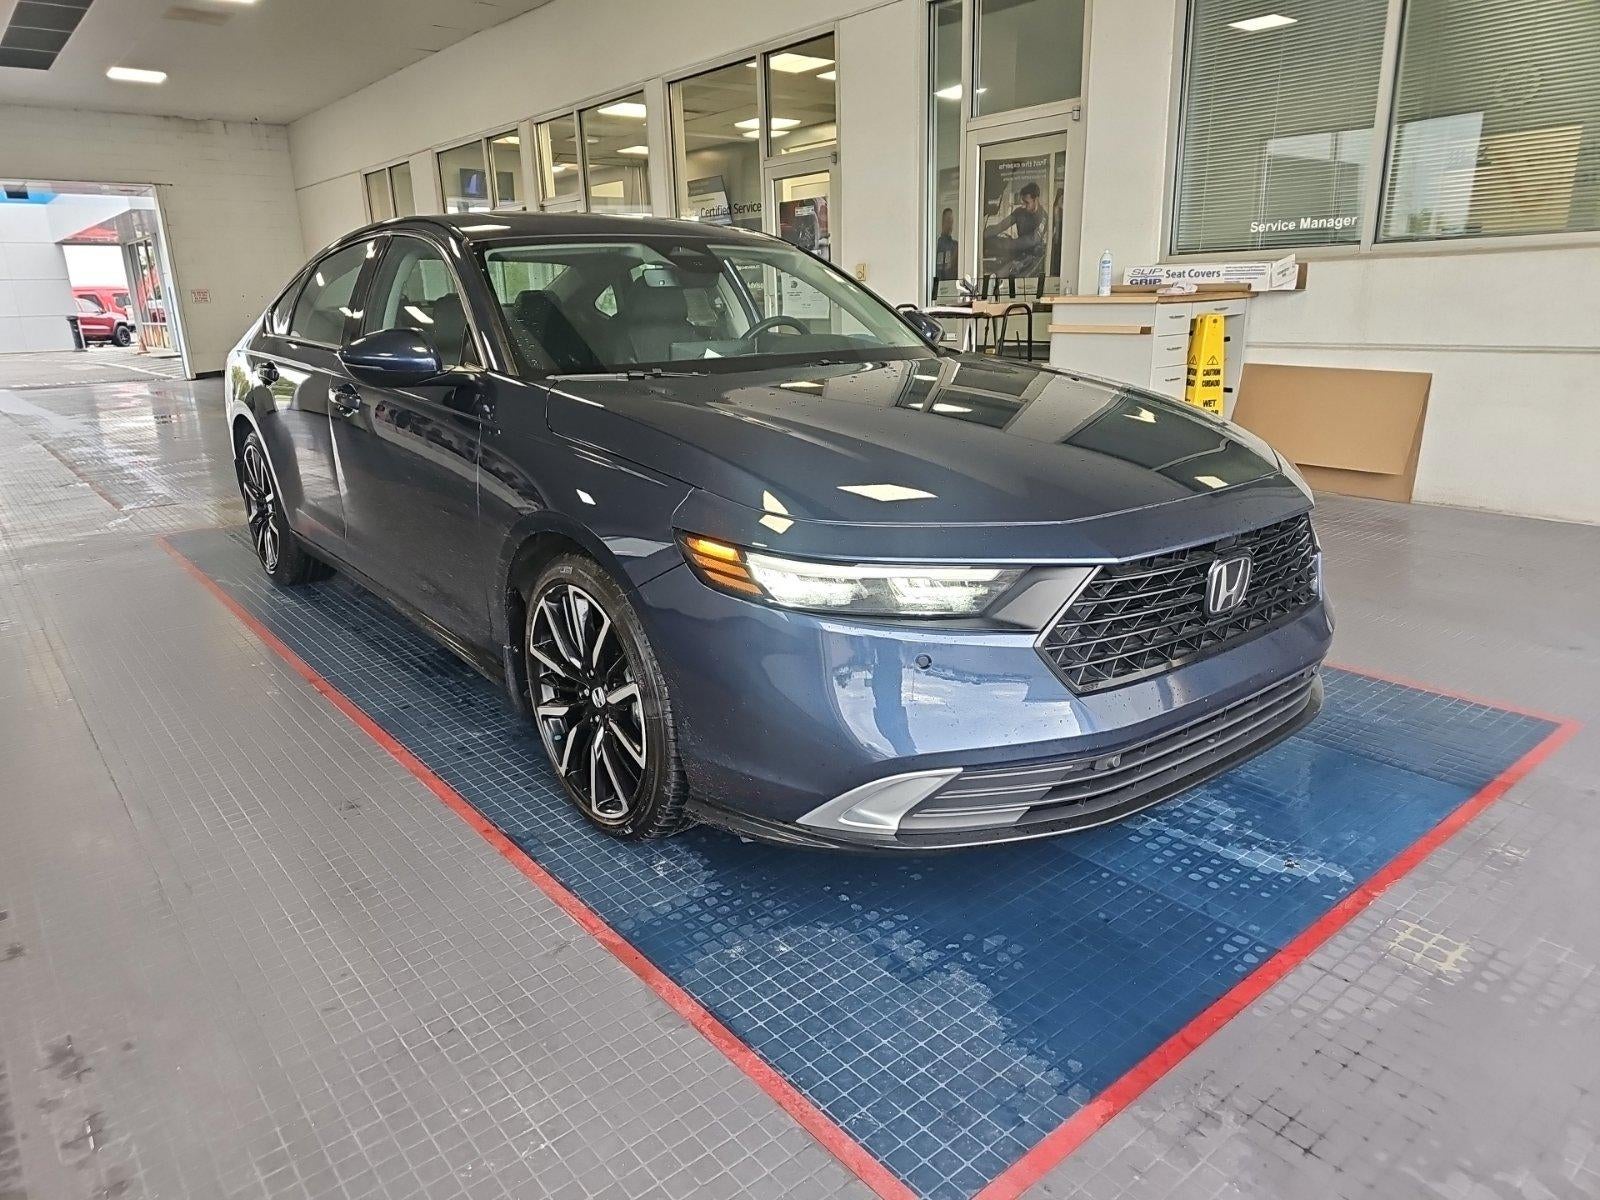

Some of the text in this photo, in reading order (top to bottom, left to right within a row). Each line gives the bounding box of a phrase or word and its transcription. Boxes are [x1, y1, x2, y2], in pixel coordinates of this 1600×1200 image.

[700, 201, 762, 218] Certified Service
[1250, 216, 1358, 233] Service Manager
[1131, 267, 1163, 275] SLIP
[1165, 269, 1187, 278] Seat
[1188, 268, 1221, 278] Covers
[1129, 278, 1162, 286] GRIP
[1202, 399, 1217, 407] WET
